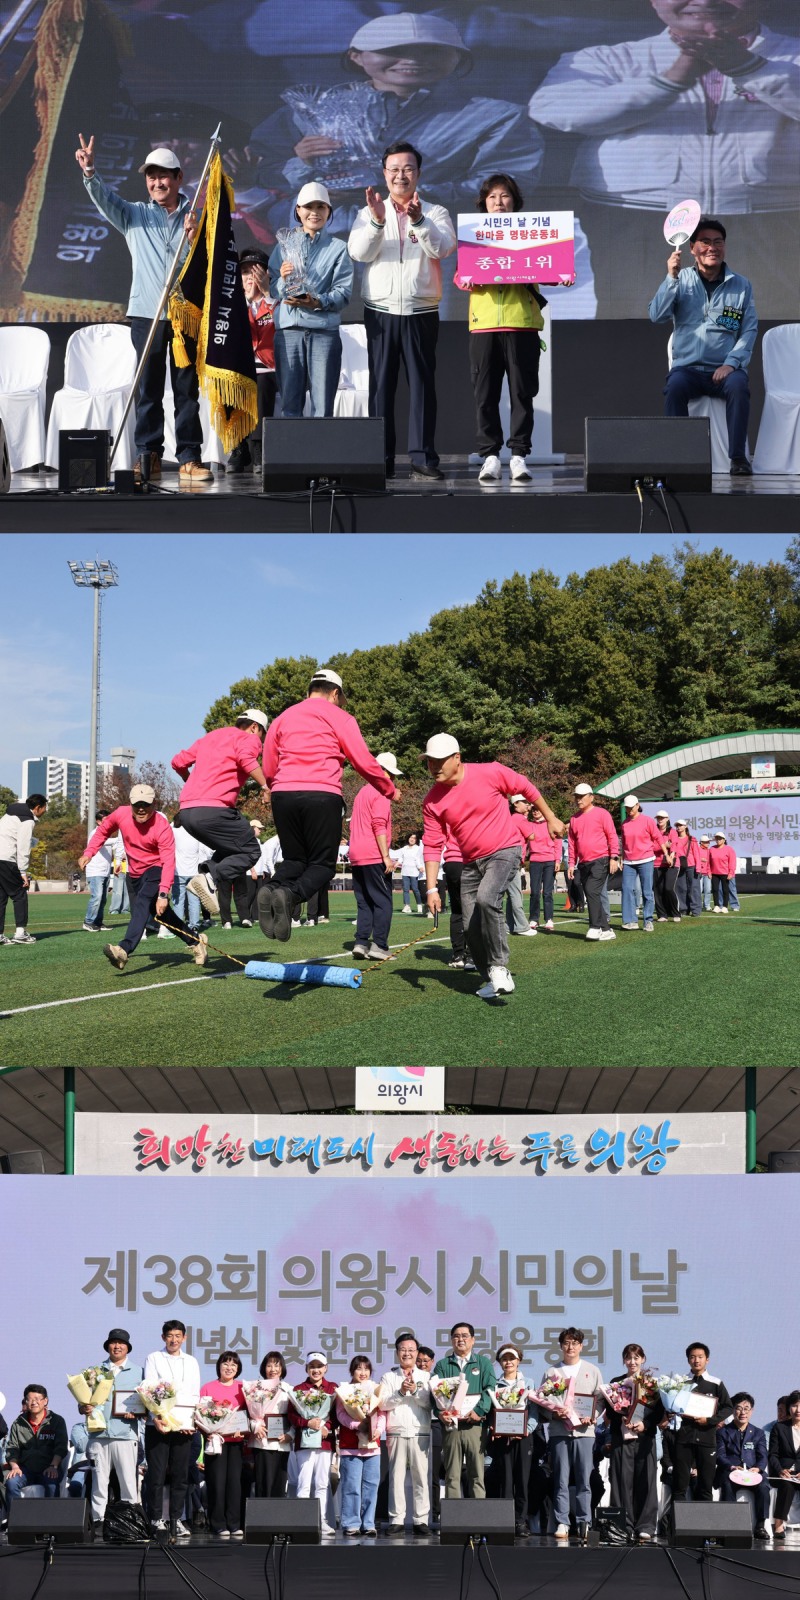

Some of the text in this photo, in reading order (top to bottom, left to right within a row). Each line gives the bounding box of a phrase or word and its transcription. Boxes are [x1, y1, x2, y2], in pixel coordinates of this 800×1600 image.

[483, 216, 551, 228] 시민의 날 기념
[475, 229, 559, 241] 한마음 명랑운동회
[475, 255, 552, 270] 종합 1위
[221, 260, 238, 299] 시민의
[213, 306, 232, 345] 의왕시
[685, 813, 800, 831] 제38회 의왕시 시민
[728, 832, 736, 841] 및
[739, 832, 764, 841] 한마음
[378, 1084, 423, 1105] 의왕시
[253, 1132, 376, 1169] 미래도시
[390, 1130, 516, 1168] 생동하는
[81, 1249, 267, 1312] 제38회
[278, 1249, 446, 1316] 의왕시
[185, 1325, 259, 1366] 념식
[274, 1325, 305, 1366] 및
